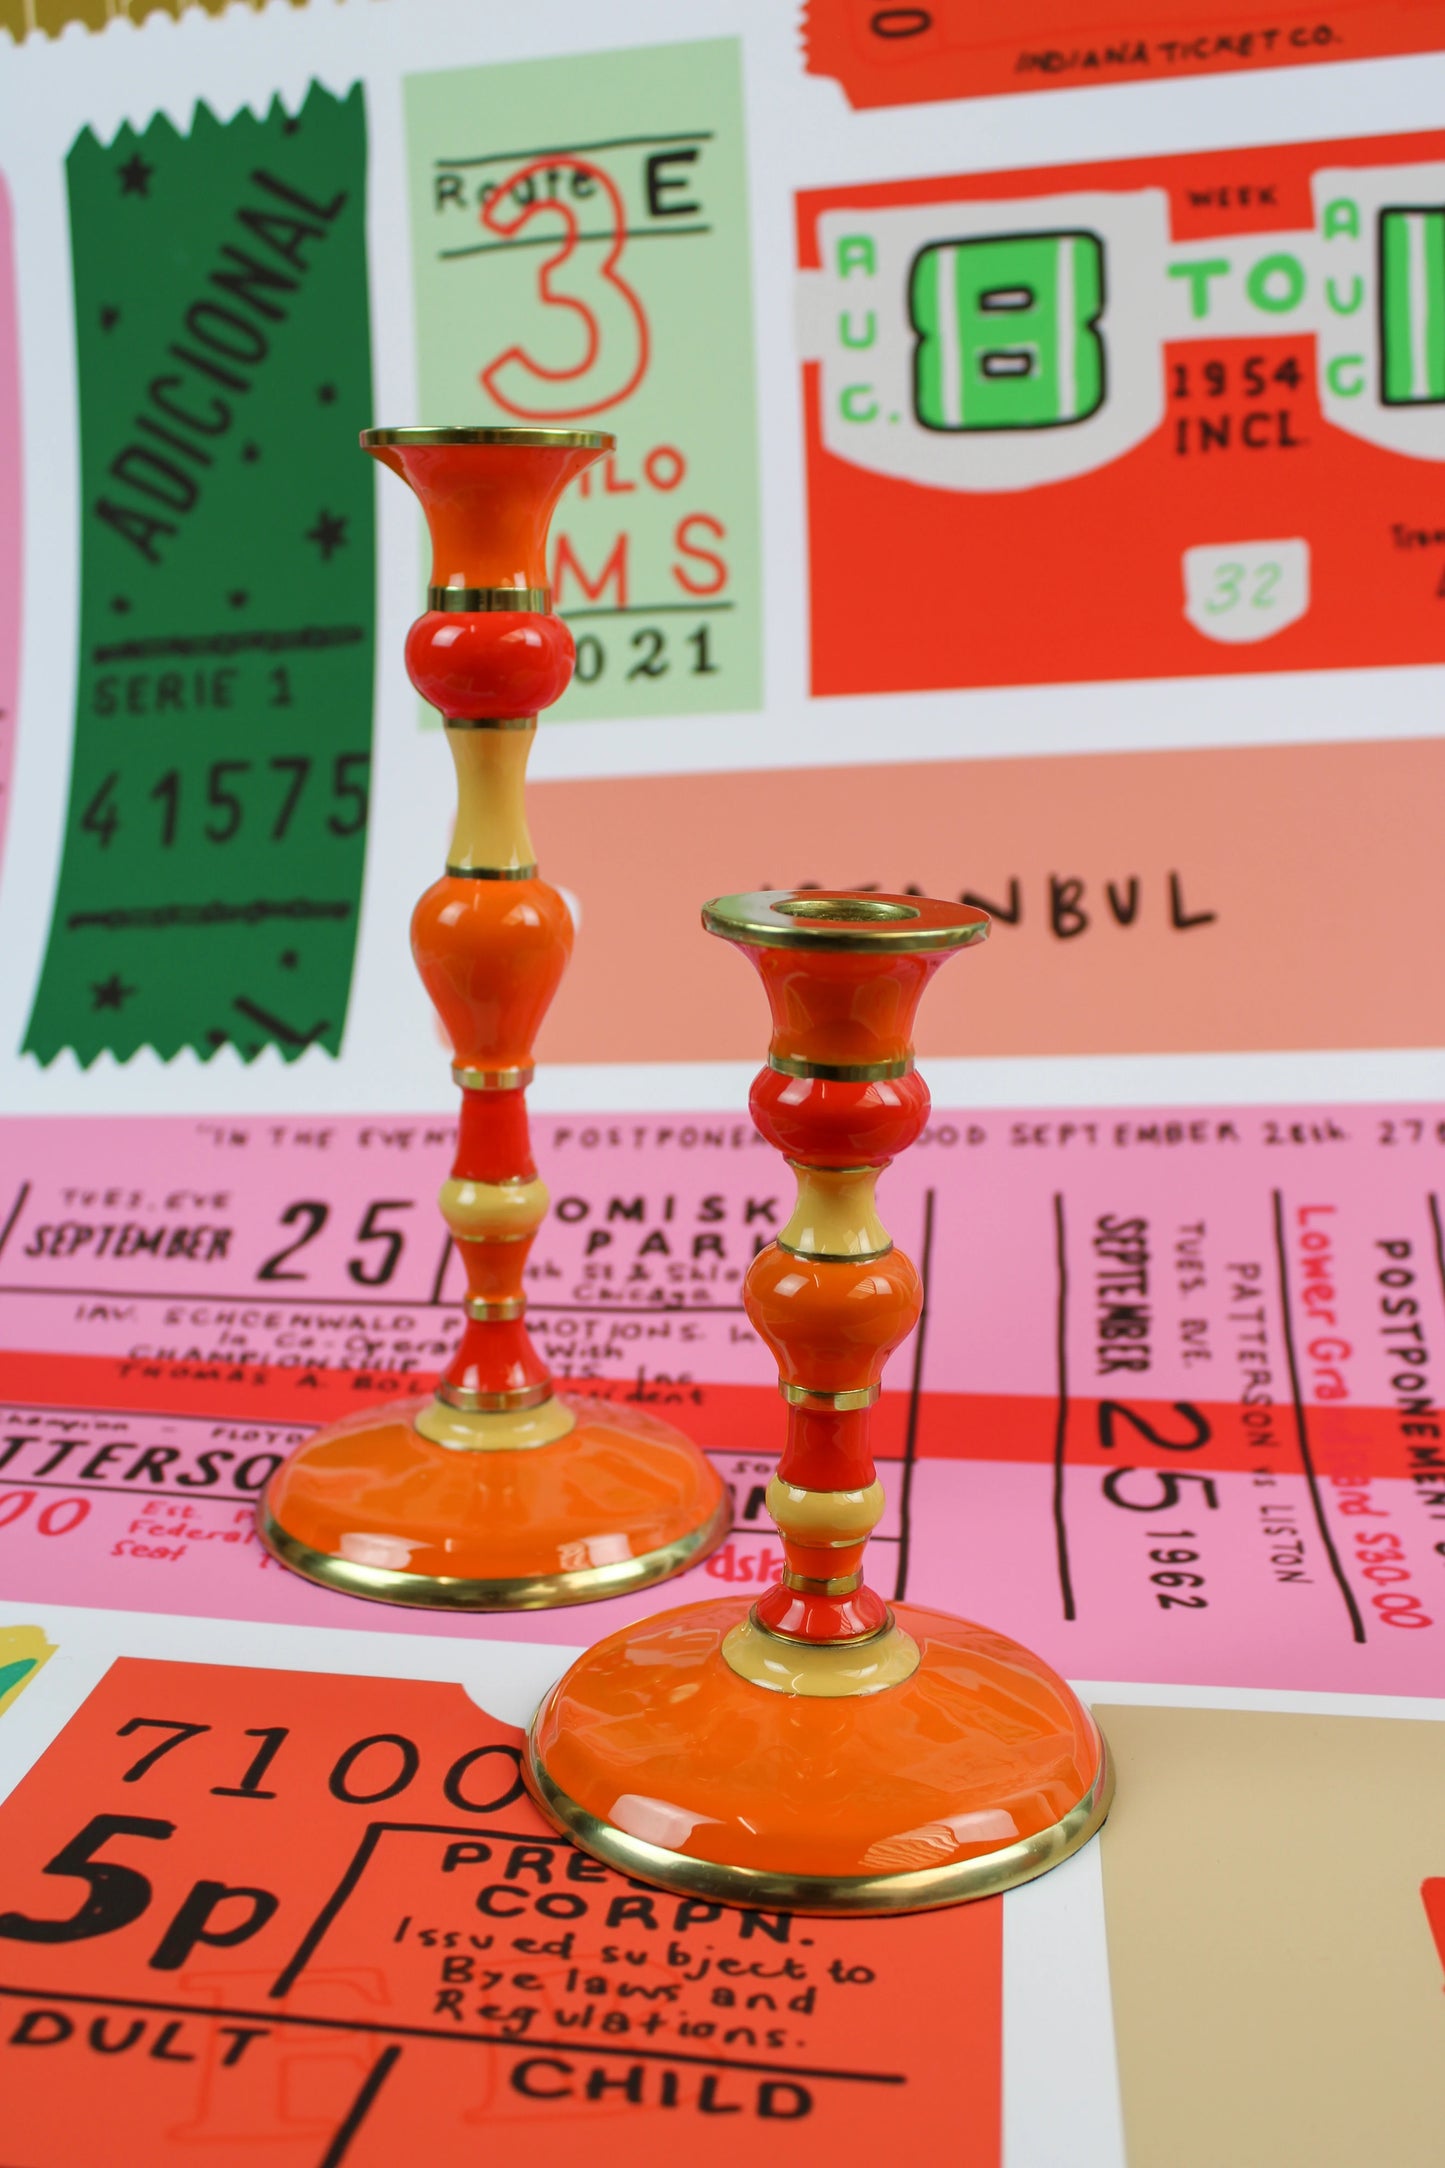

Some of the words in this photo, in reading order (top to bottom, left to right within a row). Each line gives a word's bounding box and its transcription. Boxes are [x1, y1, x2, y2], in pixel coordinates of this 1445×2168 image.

[645, 149, 702, 217] E
[479, 153, 650, 420] 3
[1167, 252, 1306, 320] TO
[96, 164, 349, 566] ADICIONAL
[1173, 356, 1304, 401] 1954
[574, 620, 720, 686] 021
[94, 668, 239, 718] SERIE
[79, 751, 371, 852] 41575
[23, 1221, 235, 1264] SEPTEMBER
[255, 1200, 415, 1286] 25
[1092, 1213, 1152, 1376] SEPTEMBER
[1099, 1400, 1219, 1513] 25
[1145, 1528, 1209, 1610] 1962
[0, 1813, 281, 1971] 5p
[8, 2008, 271, 2067] DULT
[510, 2057, 814, 2121] CHILD
